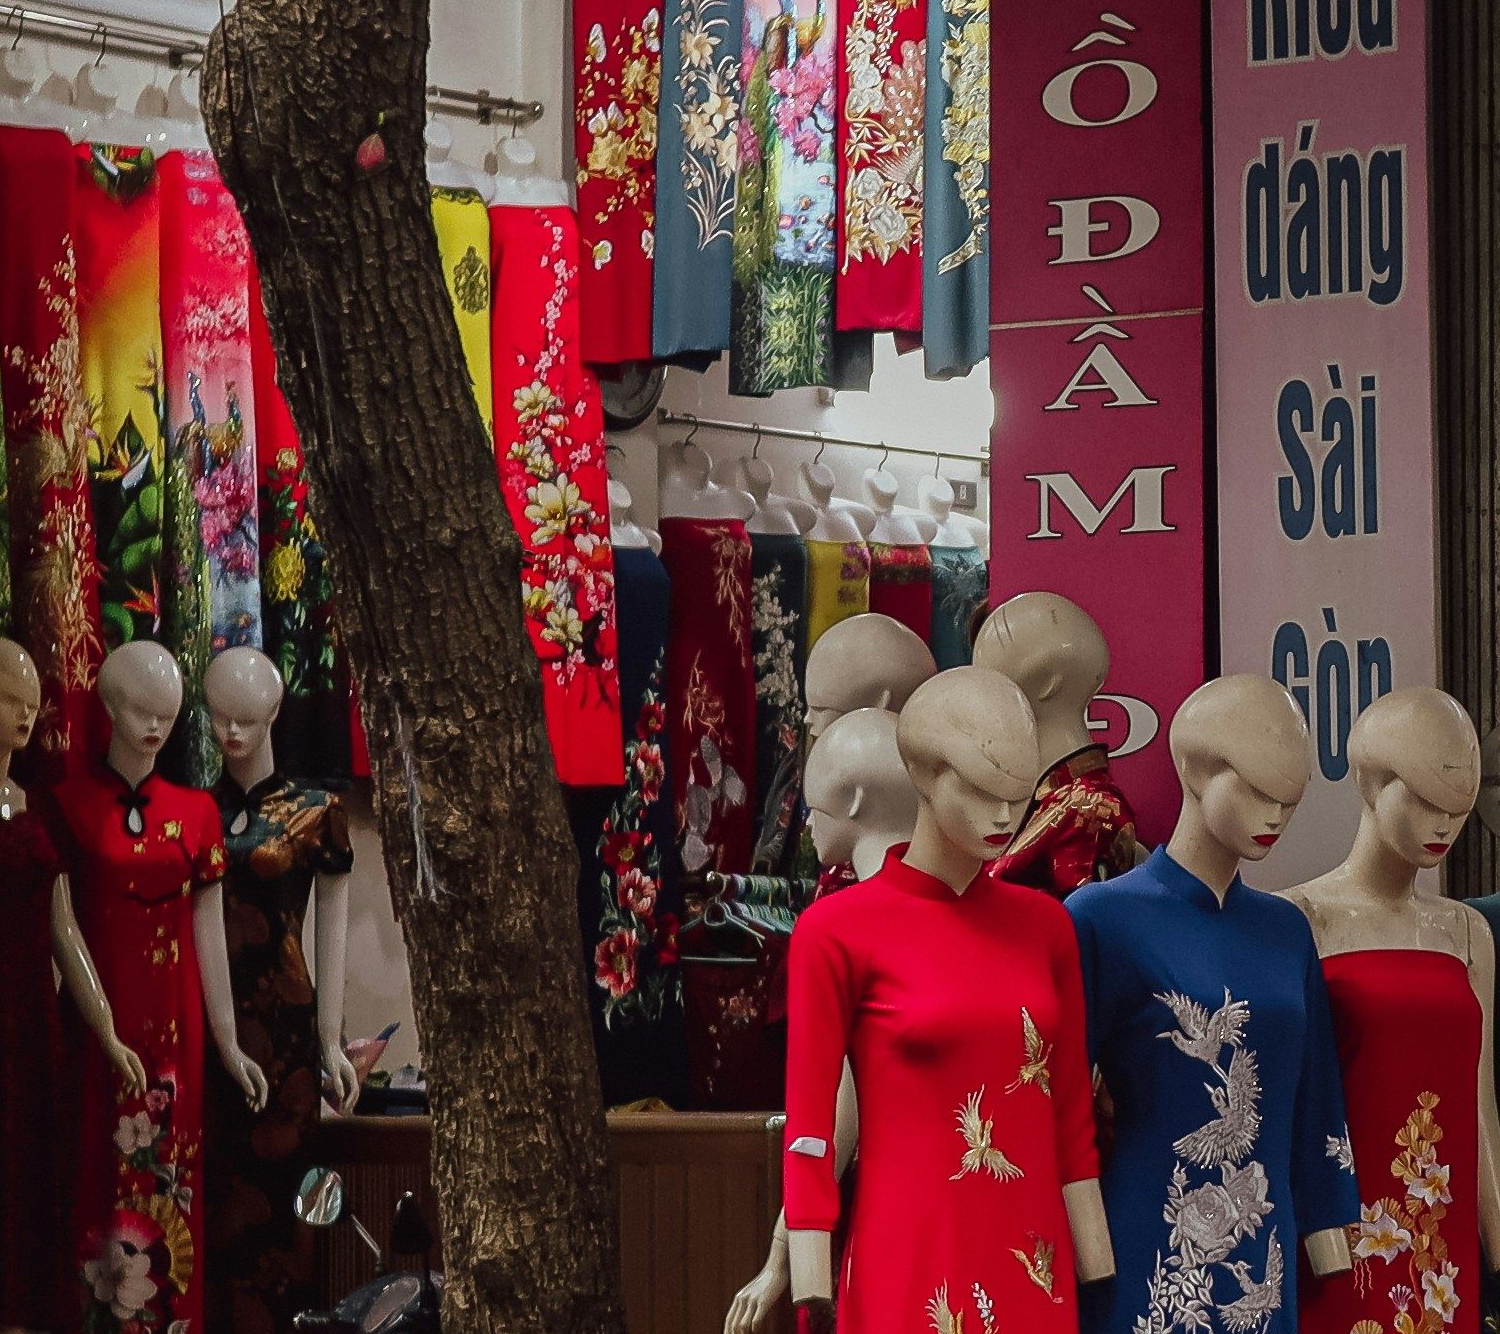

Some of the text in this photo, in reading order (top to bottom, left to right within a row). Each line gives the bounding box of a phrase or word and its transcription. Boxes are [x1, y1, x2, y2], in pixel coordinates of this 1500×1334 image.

[1244, 122, 1404, 307] dáng
[1024, 195, 1178, 540] ĐẦM
[1275, 362, 1381, 543] Sài
